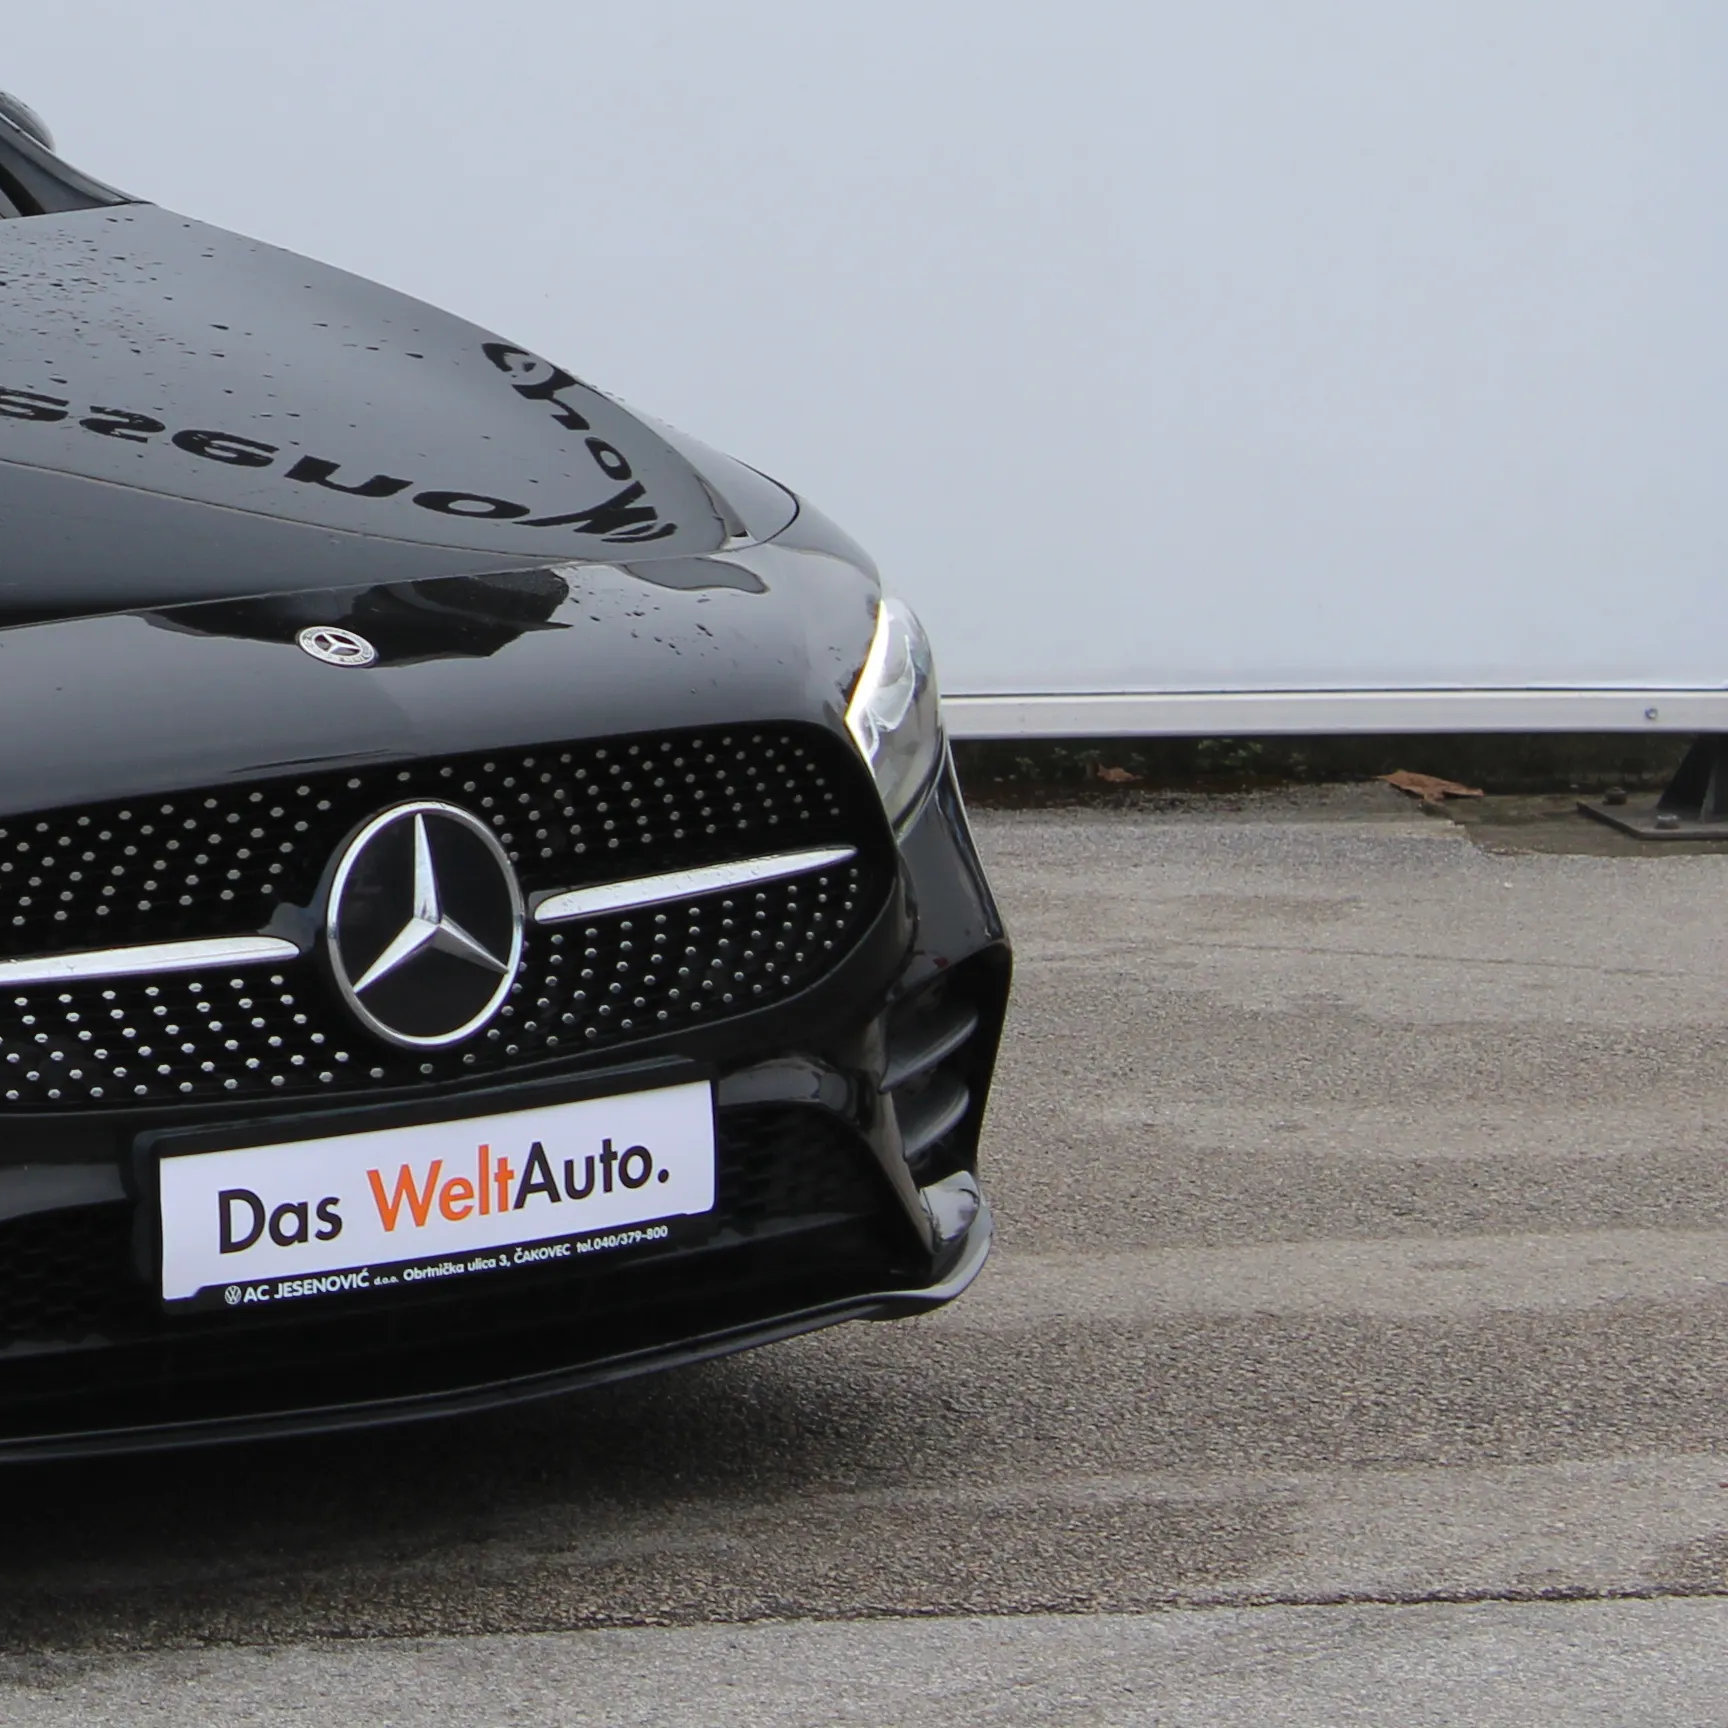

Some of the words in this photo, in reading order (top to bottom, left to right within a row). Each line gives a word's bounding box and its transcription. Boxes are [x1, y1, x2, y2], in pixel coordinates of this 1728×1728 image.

[218, 1188, 343, 1255] Das
[366, 1138, 670, 1232] WeltAuto.
[243, 1284, 271, 1303] AC
[273, 1267, 370, 1299] JESENOVIĆ
[467, 1256, 496, 1273] ulica
[513, 1245, 572, 1264] ČAKOVEC
